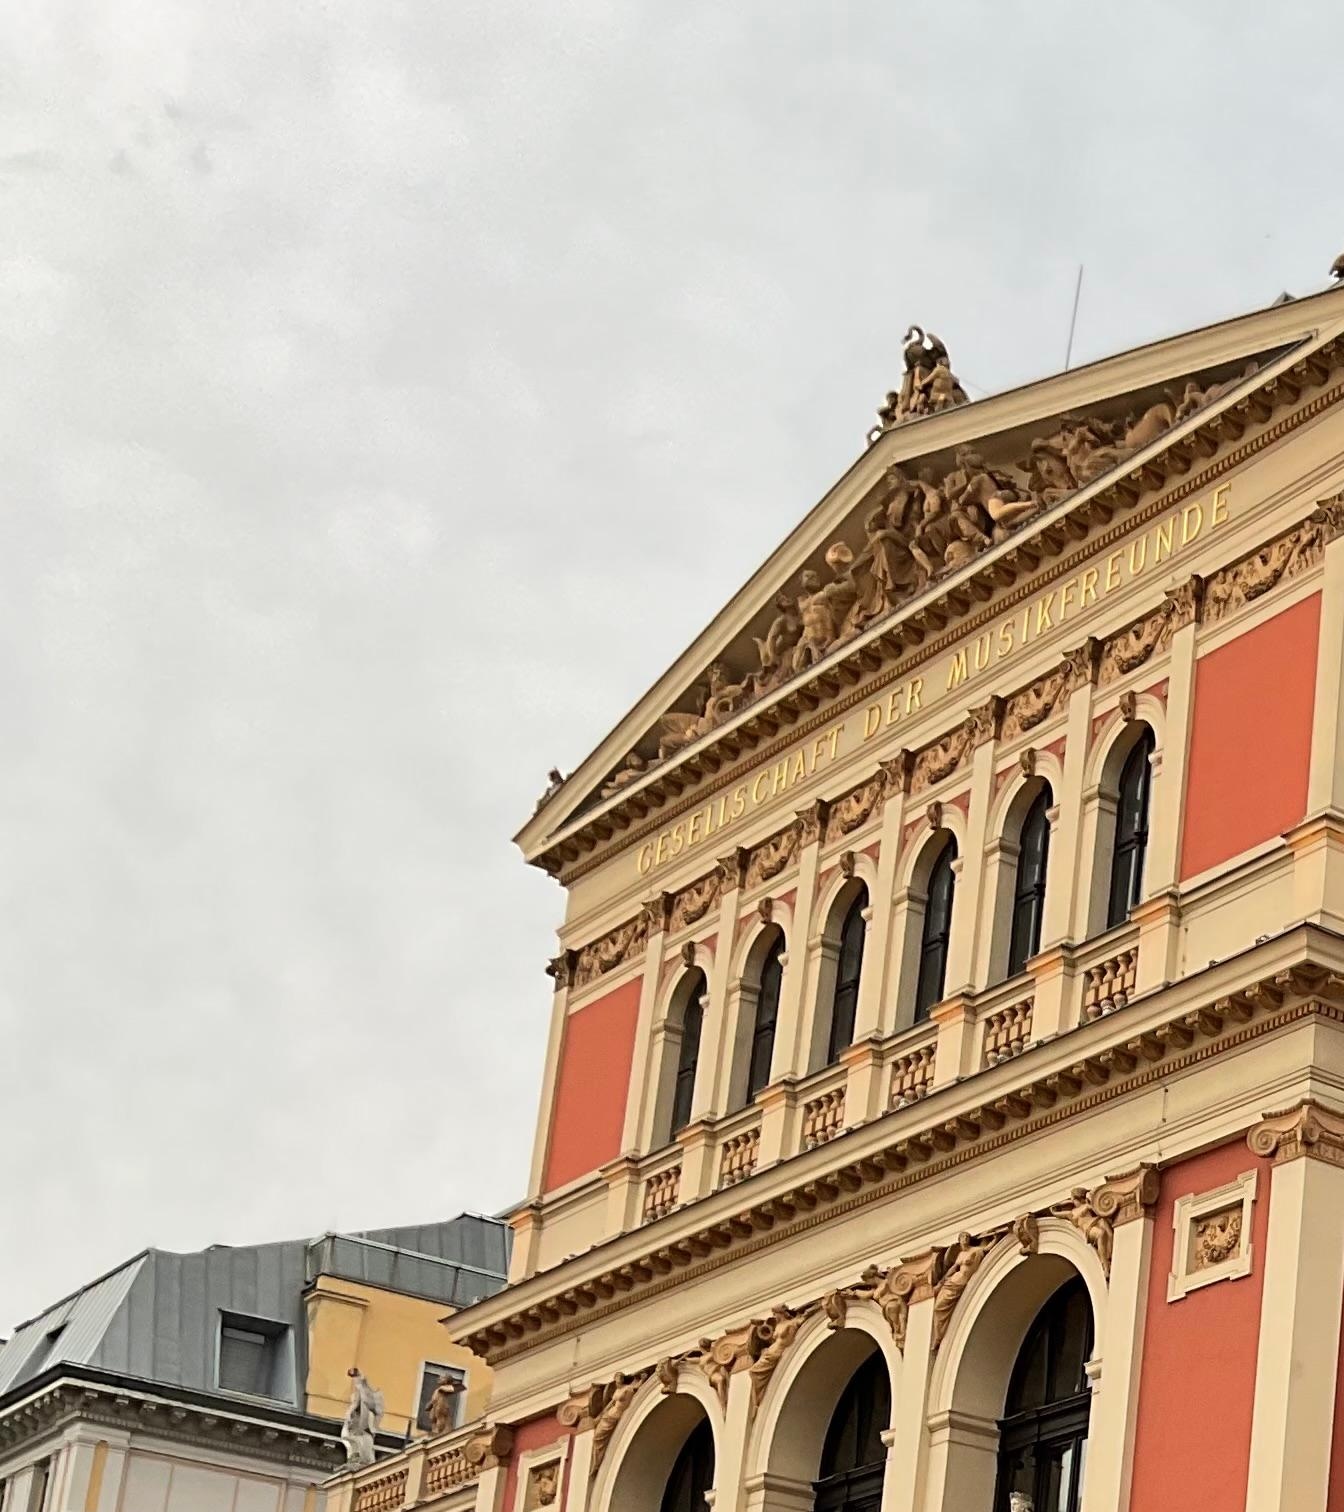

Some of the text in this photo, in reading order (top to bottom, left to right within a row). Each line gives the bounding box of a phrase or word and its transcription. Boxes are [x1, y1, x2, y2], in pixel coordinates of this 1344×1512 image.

[636, 480, 1232, 876] GESELLSCHAFT DER MUSIKFREUNDE
